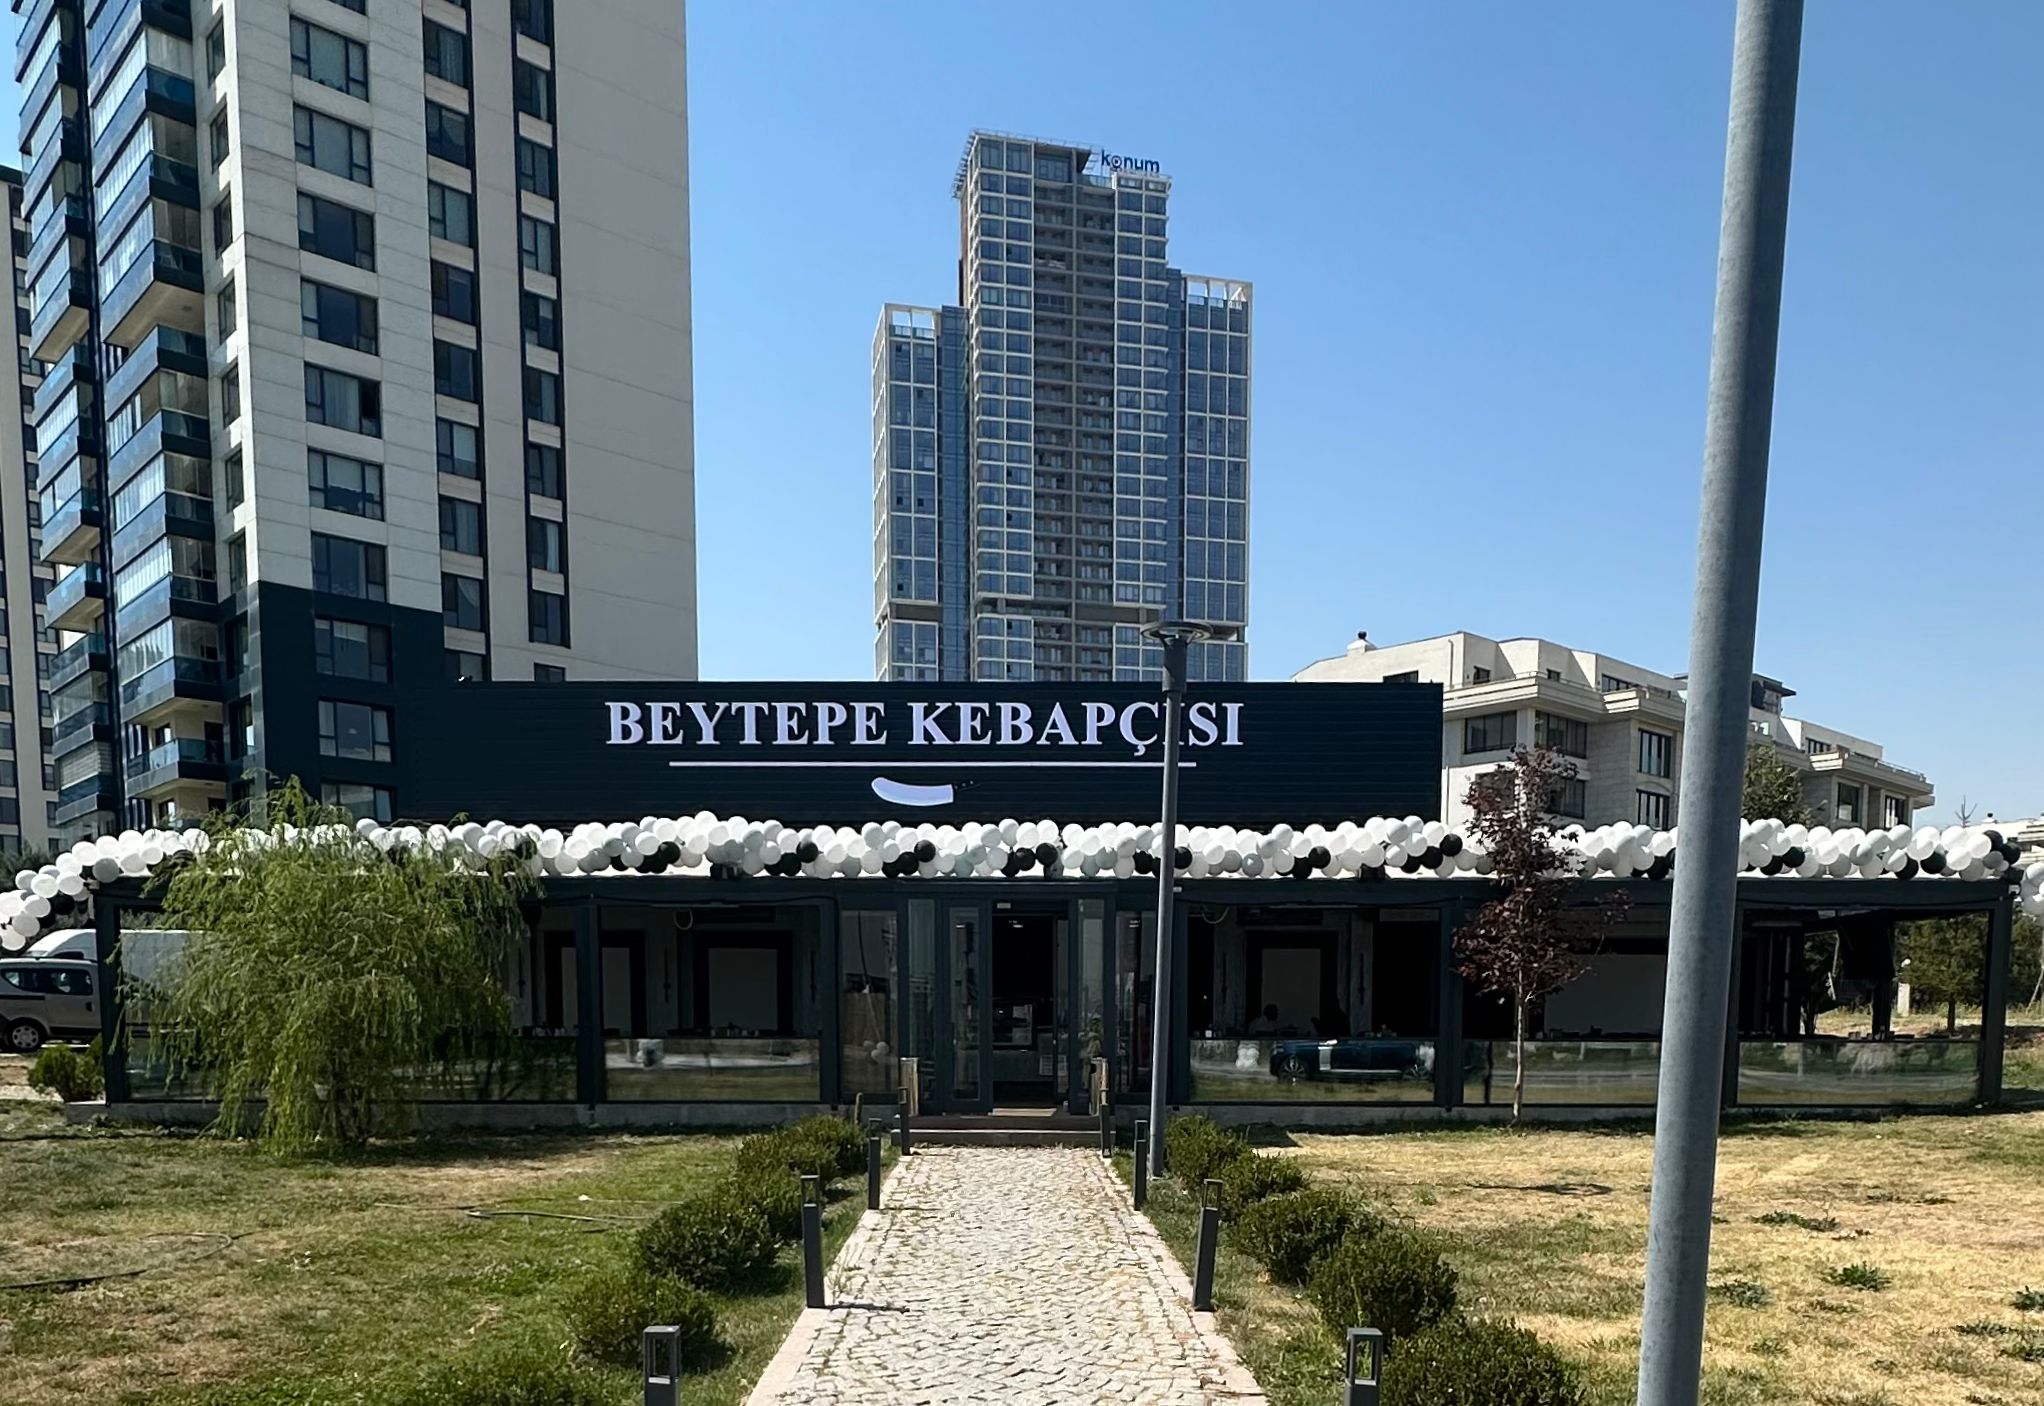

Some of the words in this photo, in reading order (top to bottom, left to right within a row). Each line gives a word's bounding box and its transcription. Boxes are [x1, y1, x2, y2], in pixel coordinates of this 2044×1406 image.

[1101, 149, 1160, 173] konum
[605, 702, 887, 745] BEYTEPE
[907, 702, 1244, 756] KEBAPÇSI
